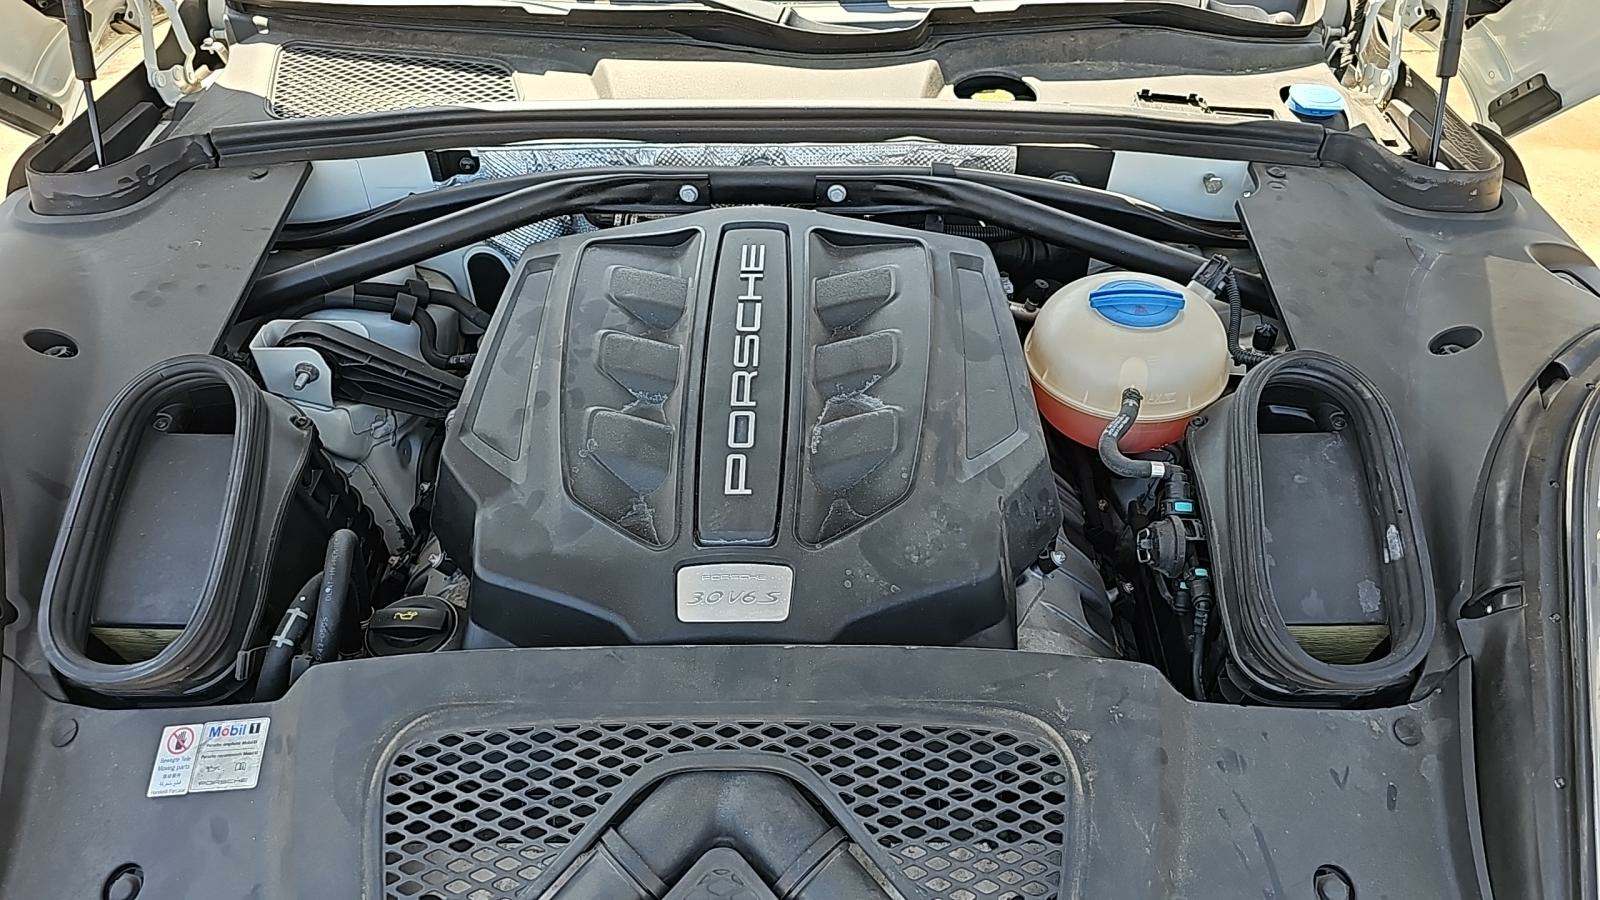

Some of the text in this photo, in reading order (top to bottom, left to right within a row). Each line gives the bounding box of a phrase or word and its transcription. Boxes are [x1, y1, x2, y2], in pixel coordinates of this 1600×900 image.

[723, 243, 766, 496] PORSCHE
[728, 589, 757, 606] V6
[757, 590, 781, 606] S
[208, 724, 247, 738] Mobil
